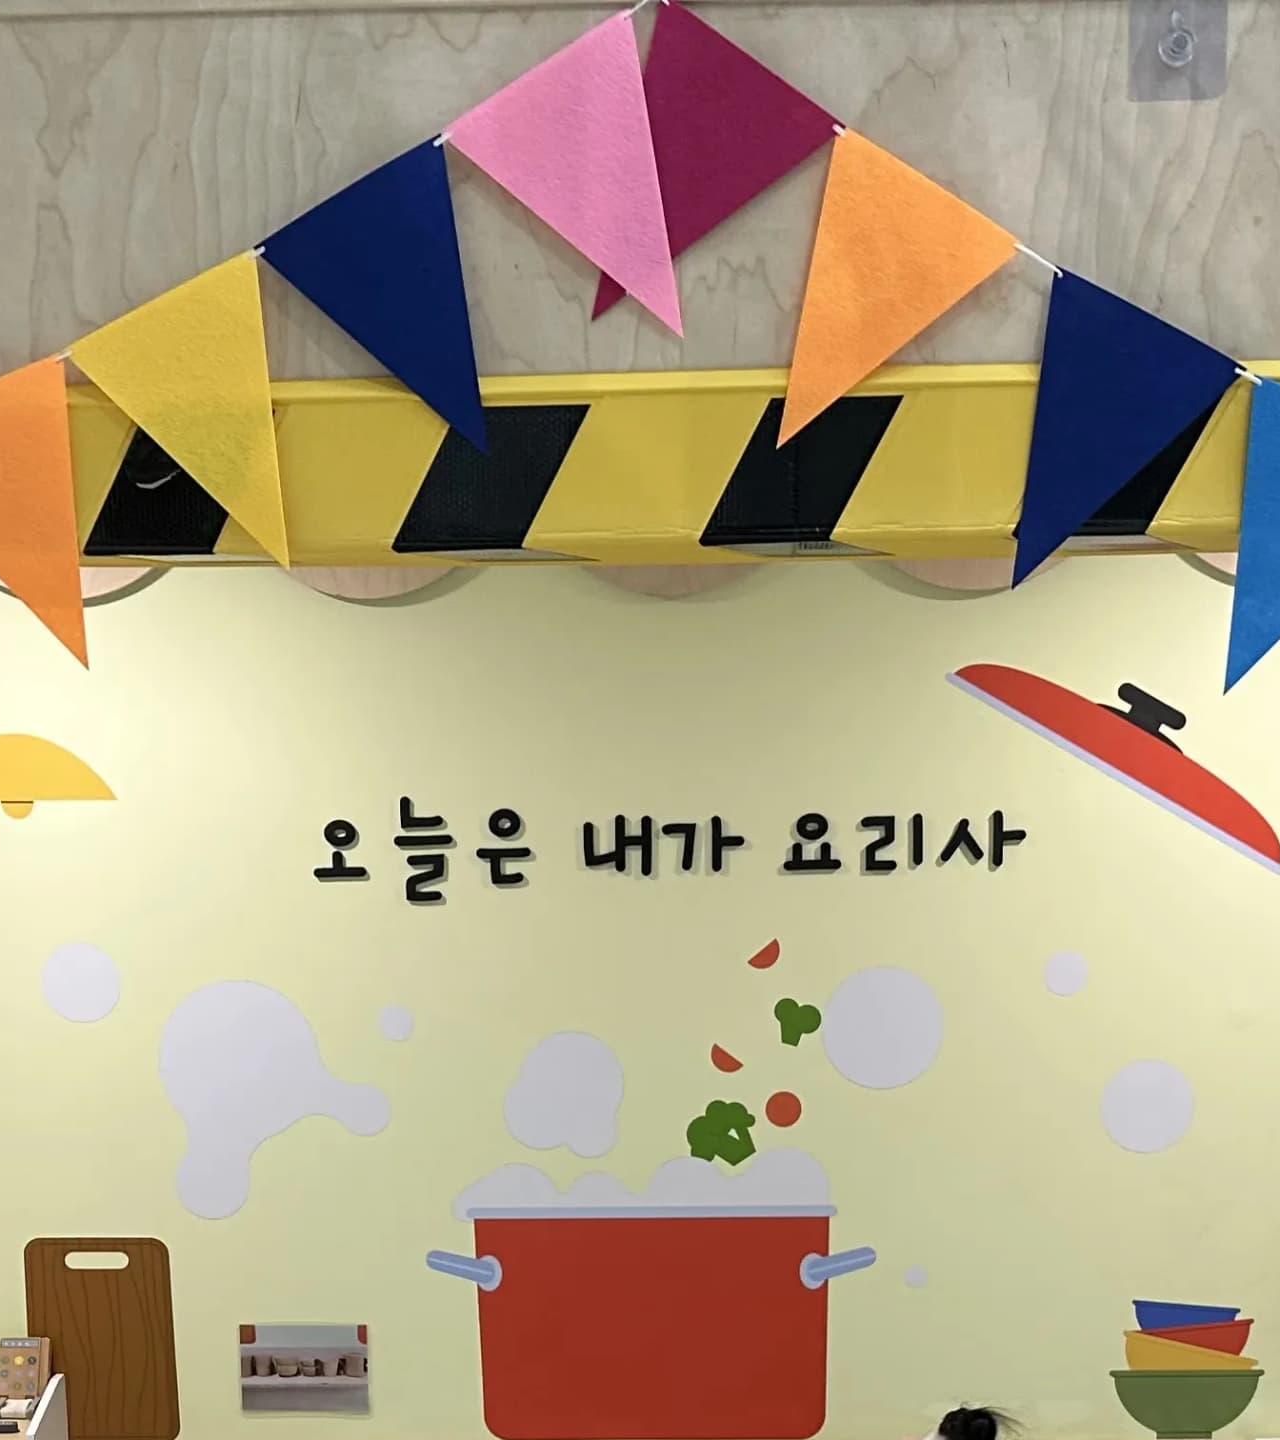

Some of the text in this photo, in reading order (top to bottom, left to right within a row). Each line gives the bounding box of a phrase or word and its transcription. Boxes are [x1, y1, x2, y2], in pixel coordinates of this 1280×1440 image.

[314, 797, 1026, 901] 오늘은 내가 요리사
